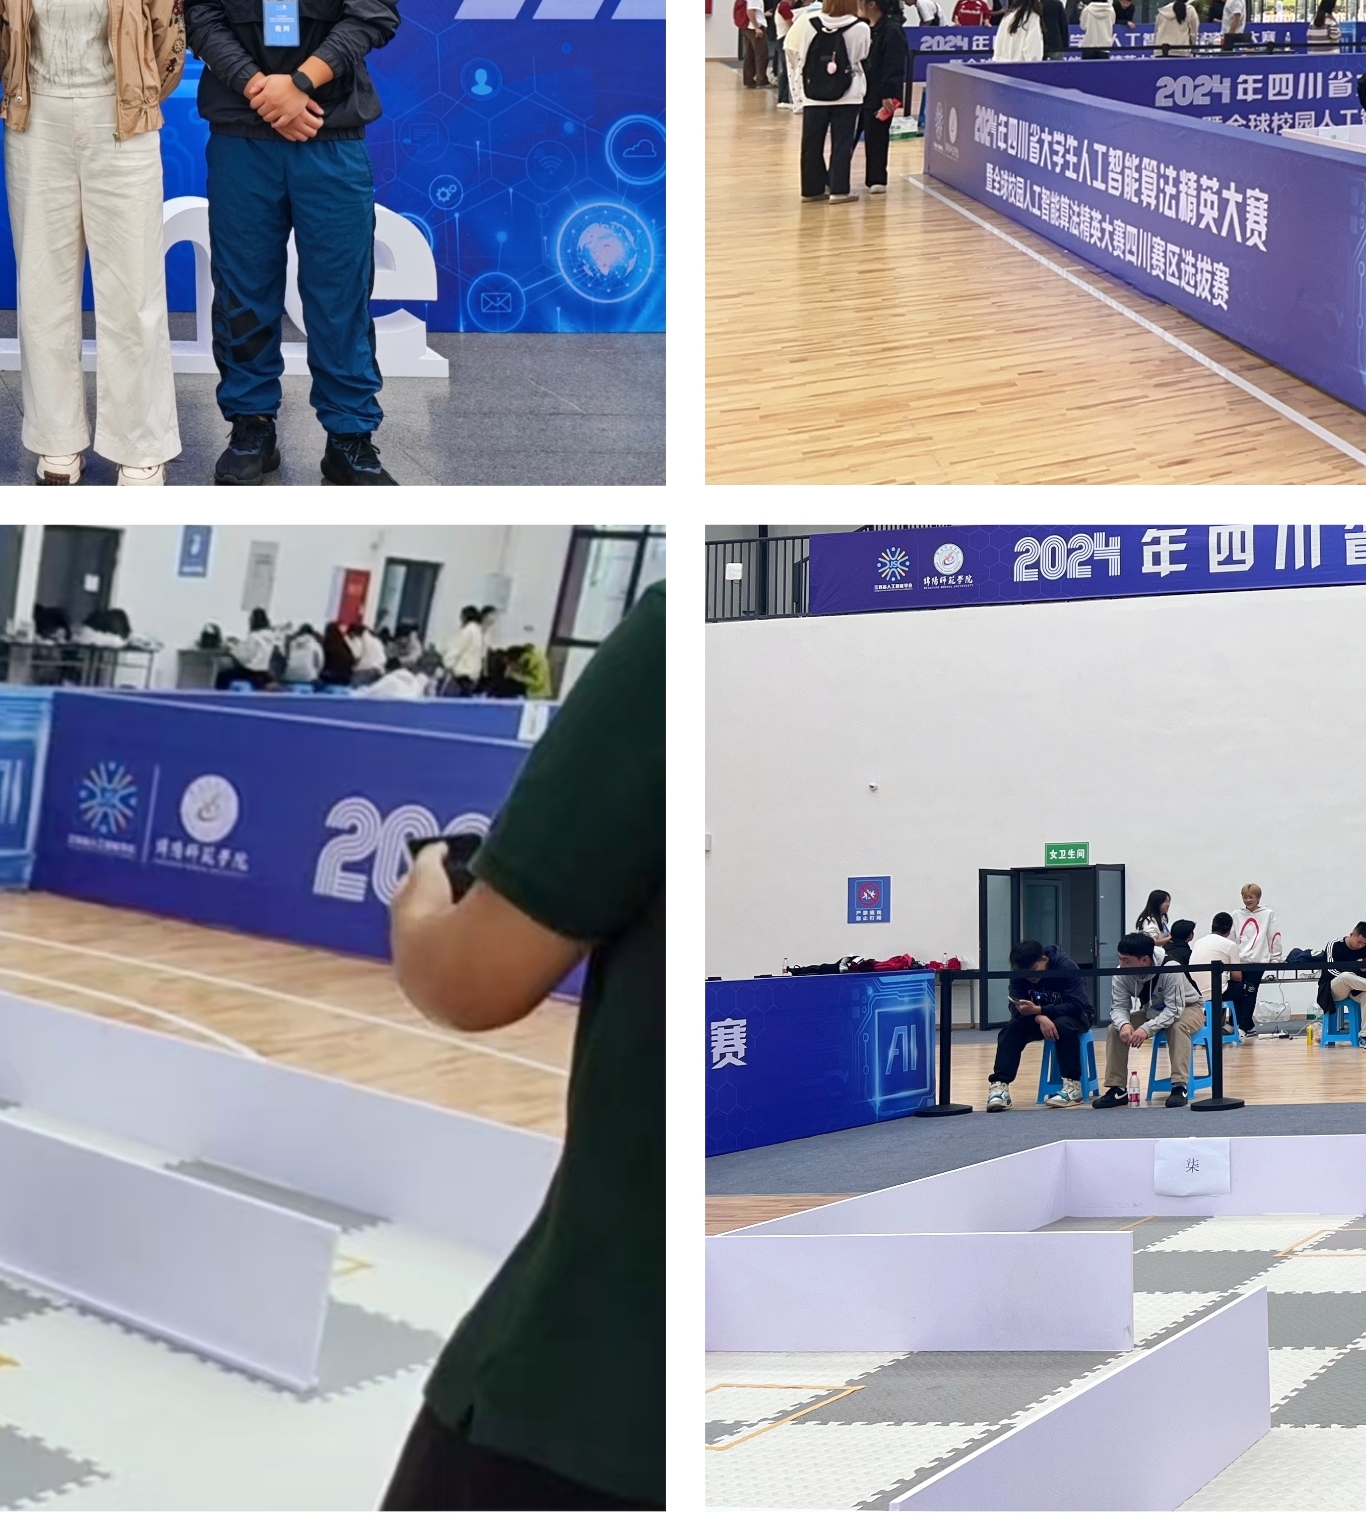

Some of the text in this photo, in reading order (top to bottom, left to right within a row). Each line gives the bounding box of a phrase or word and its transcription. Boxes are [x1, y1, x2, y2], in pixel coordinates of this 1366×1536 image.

[1049, 848, 1085, 859] 女卫生间
[710, 1017, 747, 1070] 赛
[885, 1024, 918, 1075] AI
